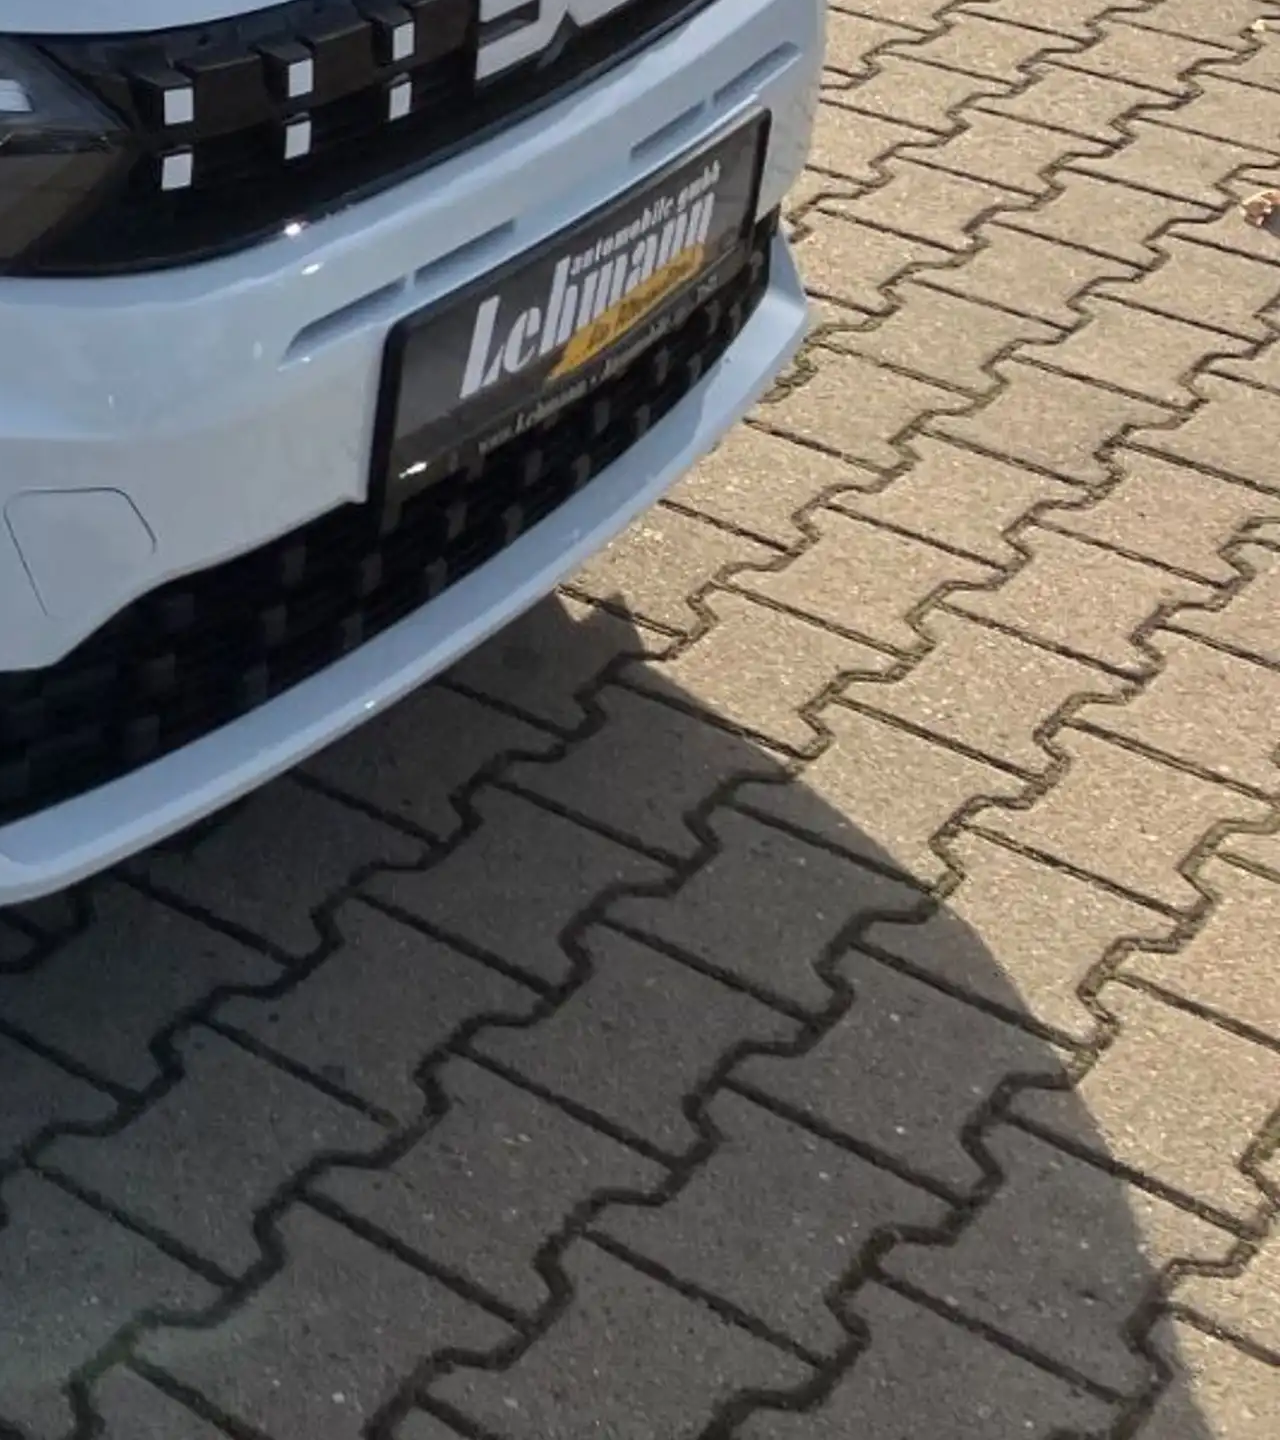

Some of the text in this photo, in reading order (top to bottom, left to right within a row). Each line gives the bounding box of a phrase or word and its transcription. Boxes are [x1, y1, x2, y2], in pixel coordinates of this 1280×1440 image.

[459, 193, 715, 400] Lehmann
[569, 160, 721, 275] automobile gmbh
